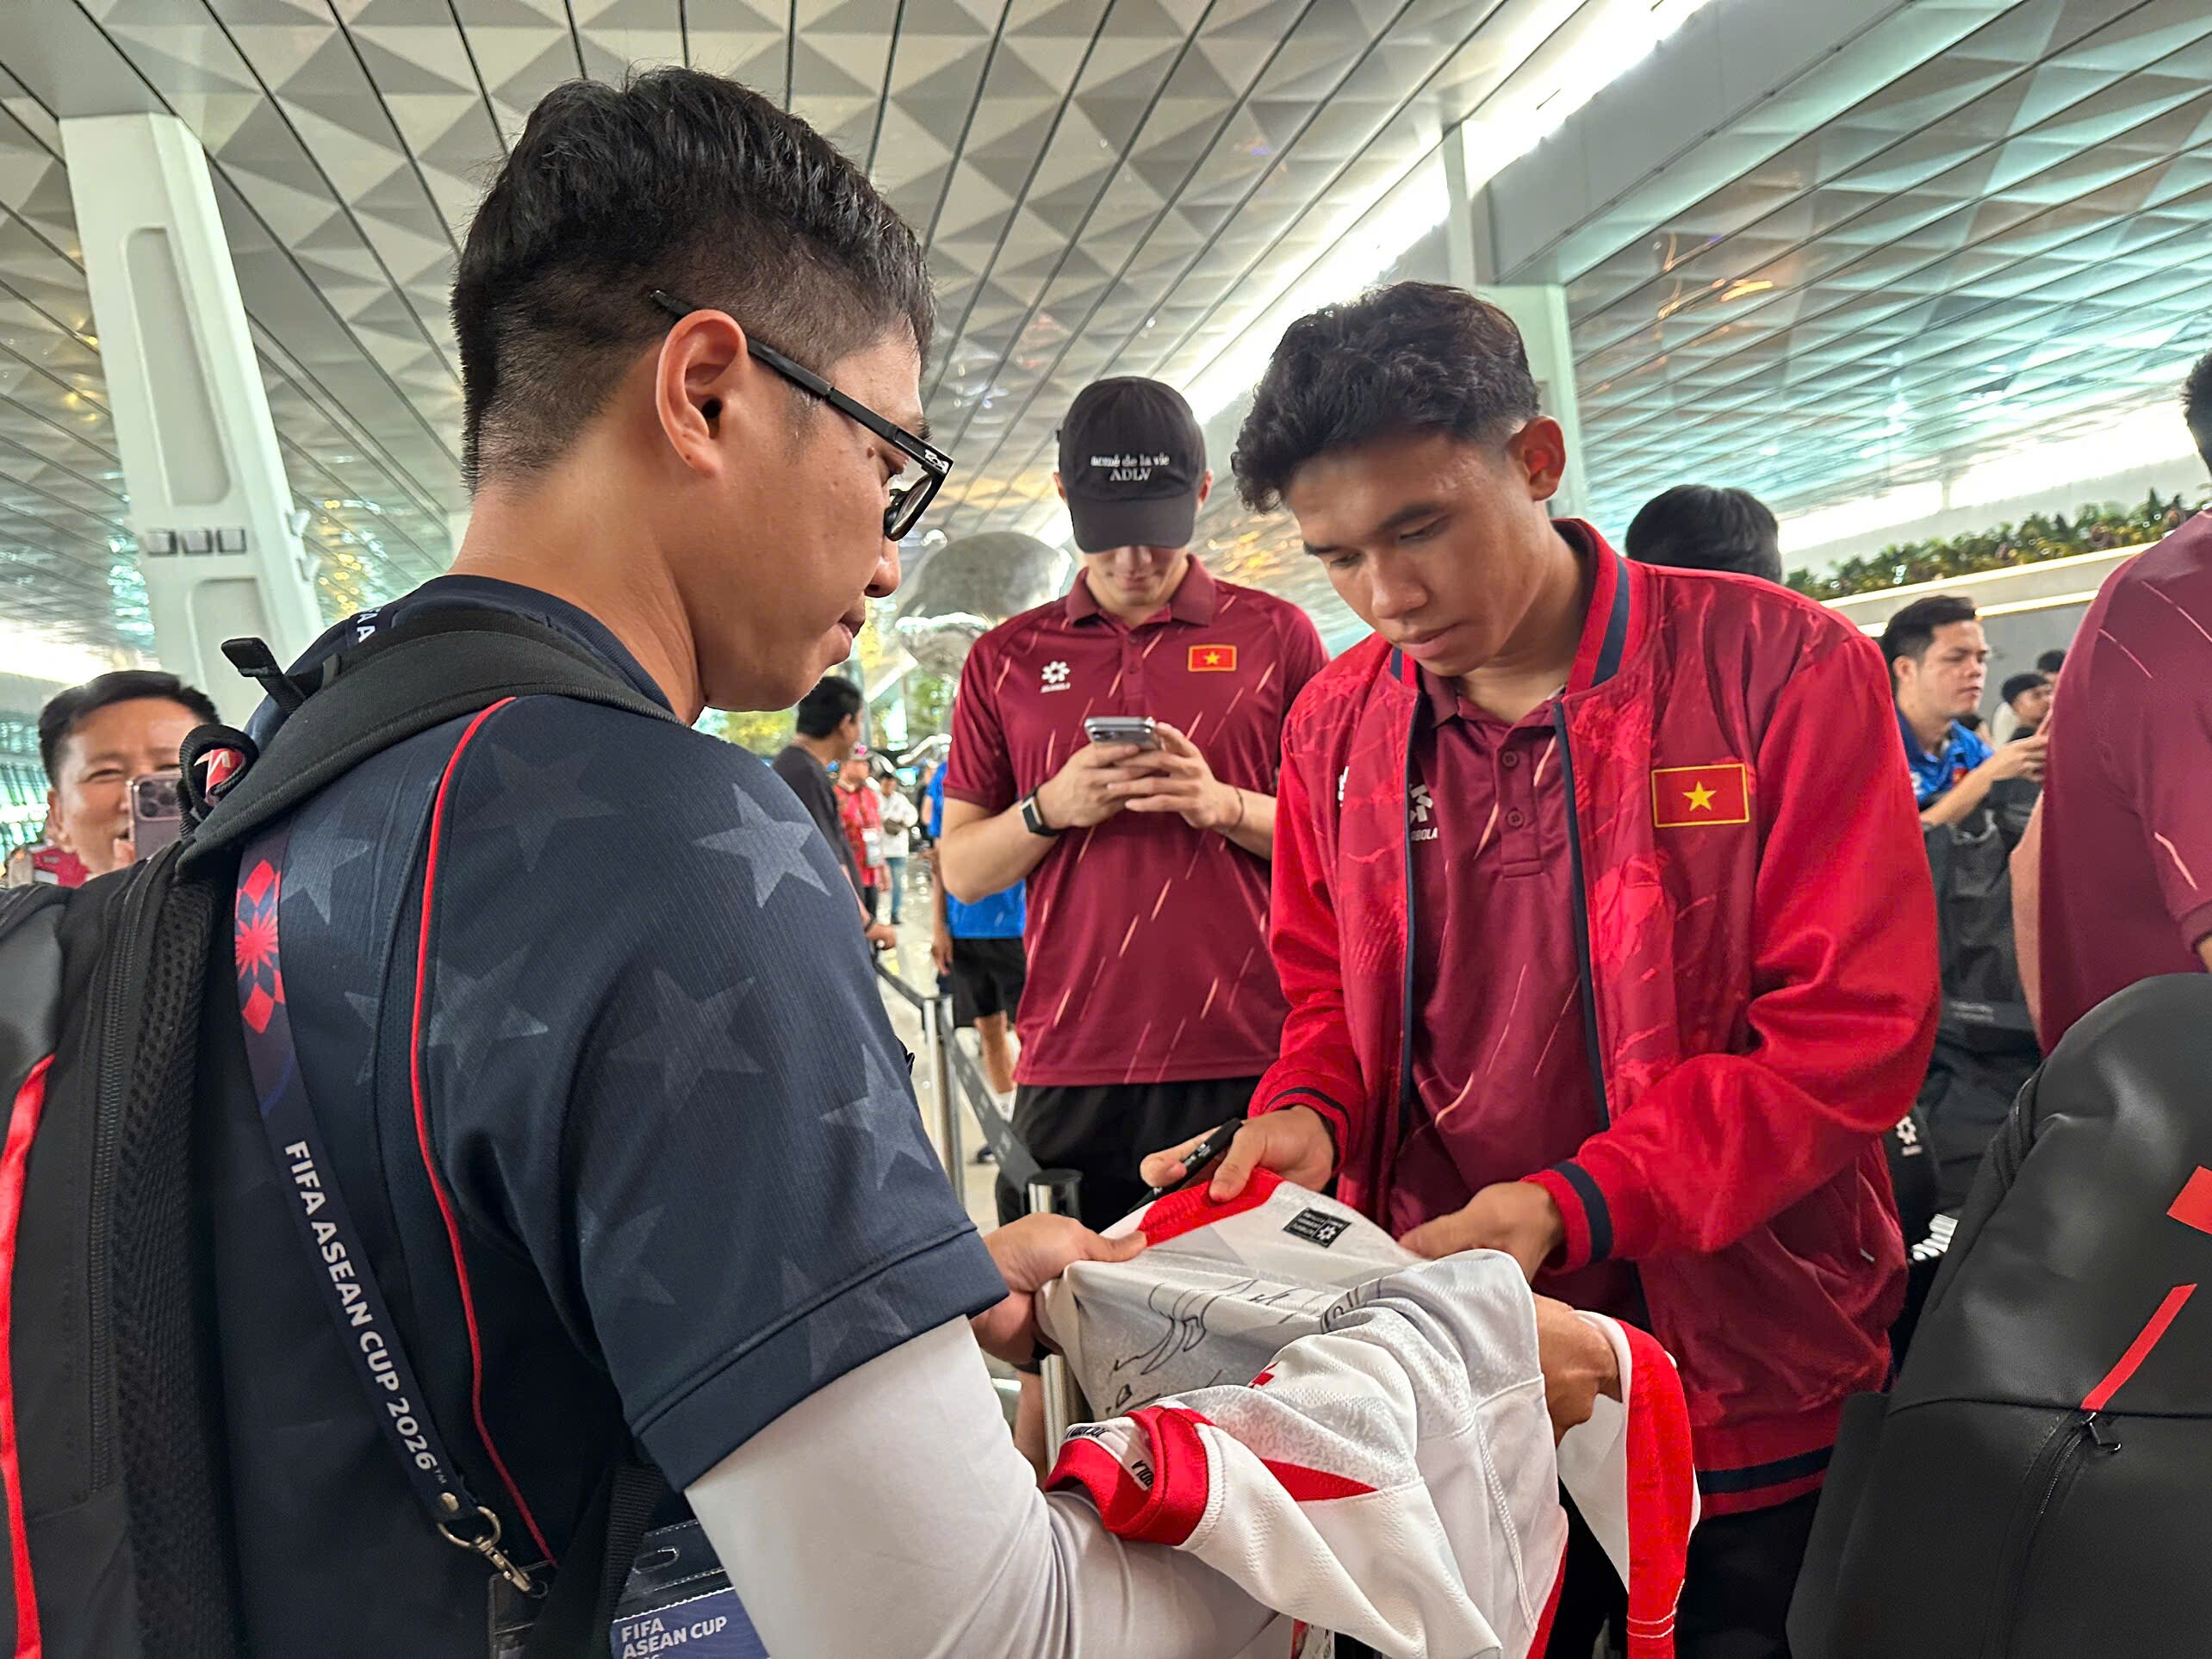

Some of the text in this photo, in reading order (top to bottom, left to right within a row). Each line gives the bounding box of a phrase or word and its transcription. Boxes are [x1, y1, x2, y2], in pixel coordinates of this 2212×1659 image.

[1122, 454, 1138, 467] de
[1140, 453, 1153, 466] la
[1153, 452, 1170, 466] vie
[1109, 468, 1152, 481] ADLV
[285, 1140, 326, 1215] FIFA
[311, 1221, 373, 1327] ASEAN
[360, 1331, 400, 1391] CUP
[621, 1618, 665, 1643] FIFA
[623, 1616, 727, 1659] ASEAN CUP
